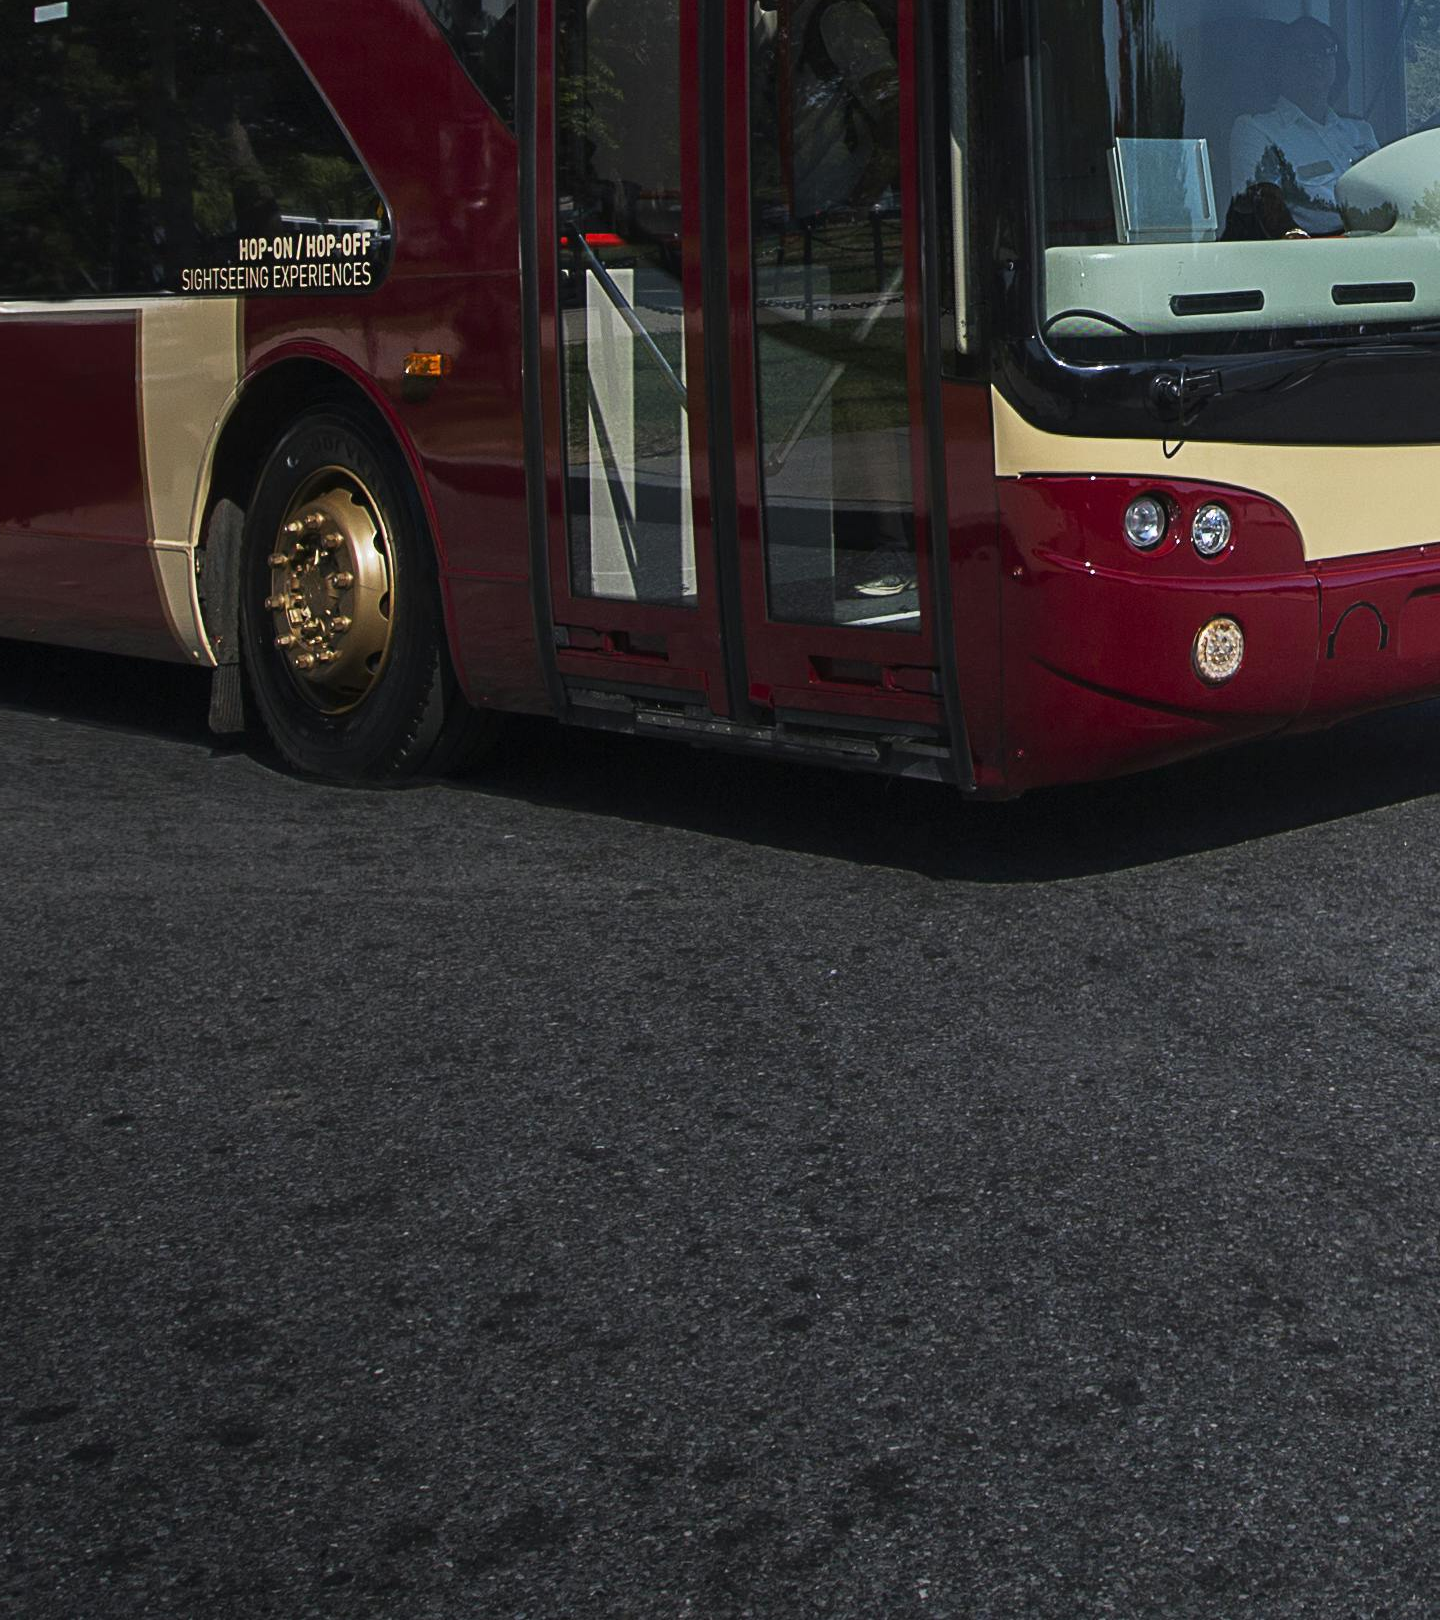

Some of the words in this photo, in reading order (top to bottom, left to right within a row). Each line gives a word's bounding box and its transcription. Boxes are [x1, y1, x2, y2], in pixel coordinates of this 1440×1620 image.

[239, 236, 293, 261] HOP-ON
[306, 231, 371, 258] HOP-OFF
[182, 265, 269, 291] SIGHTSEEING
[273, 261, 372, 289] EXPERIENCES
